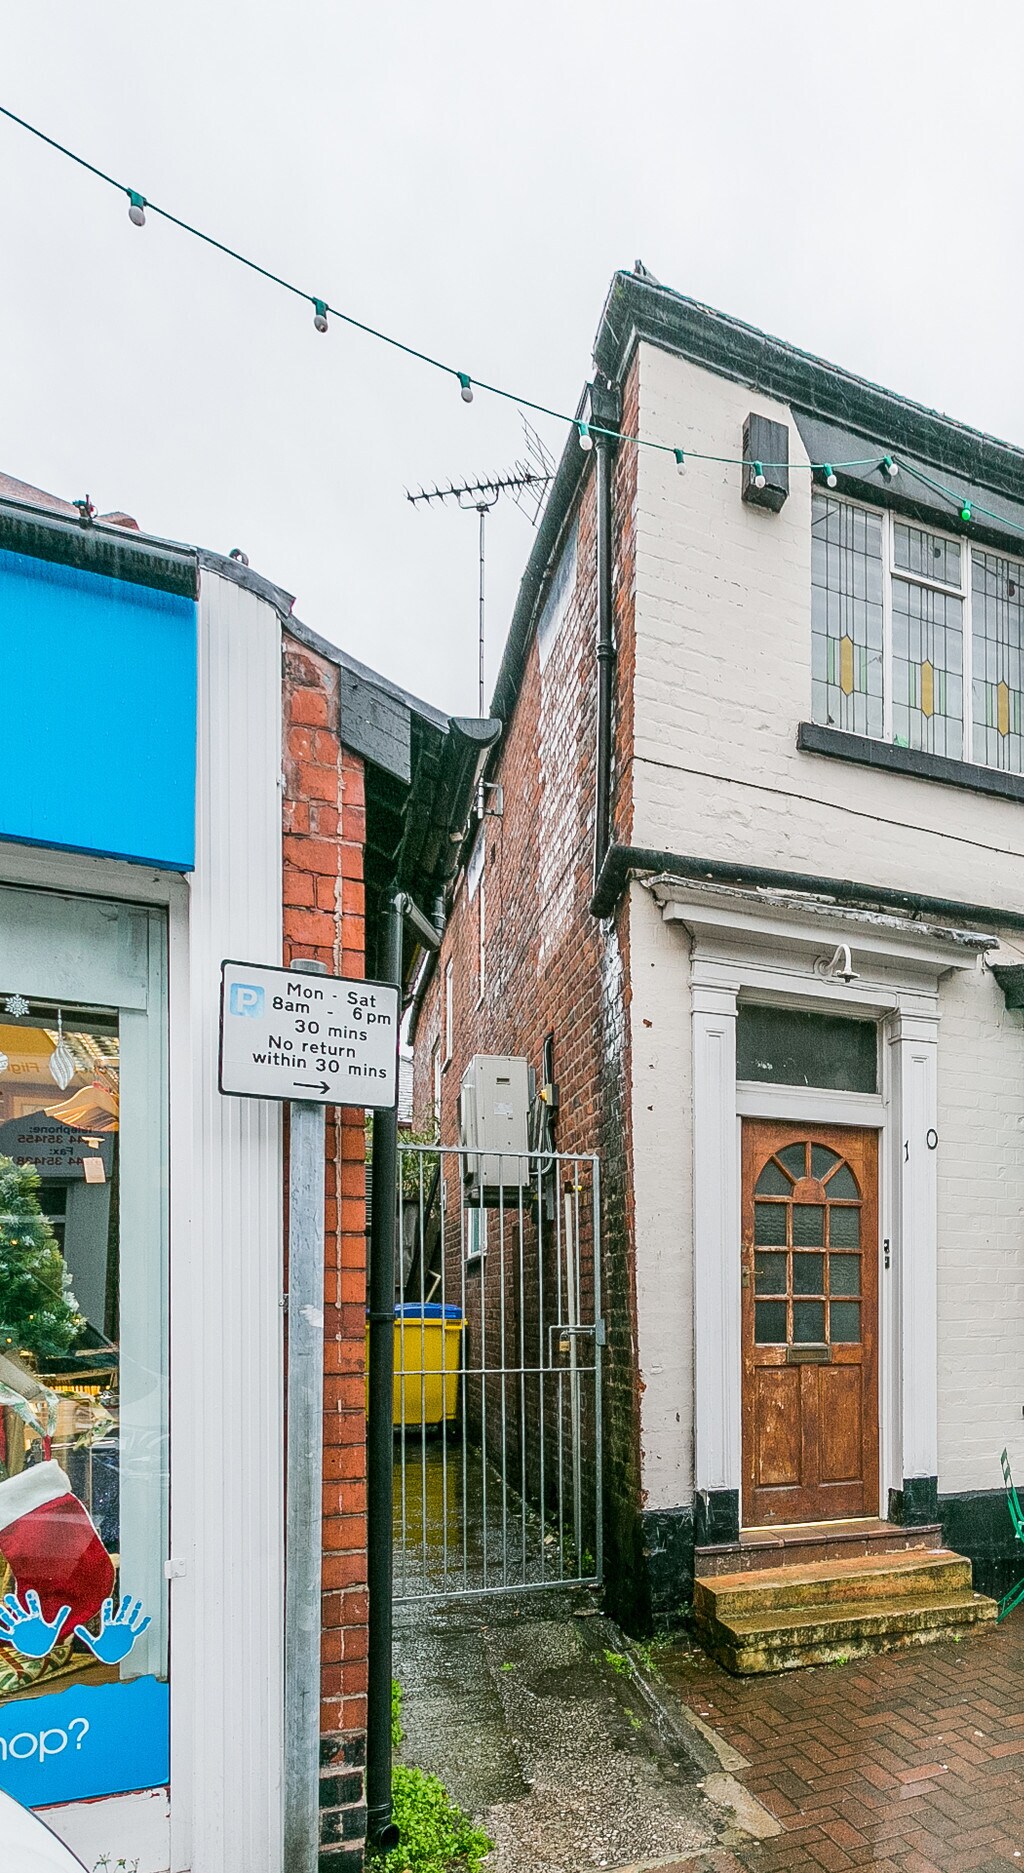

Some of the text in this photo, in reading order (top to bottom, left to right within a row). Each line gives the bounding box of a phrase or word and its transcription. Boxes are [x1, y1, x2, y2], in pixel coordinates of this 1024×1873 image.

[272, 996, 310, 1014] 8am
[287, 982, 323, 1000] Mon
[347, 991, 376, 1008] Sat
[294, 1019, 368, 1041] 30 mins
[268, 1035, 356, 1058] No return
[252, 1051, 387, 1079] within 30 mins
